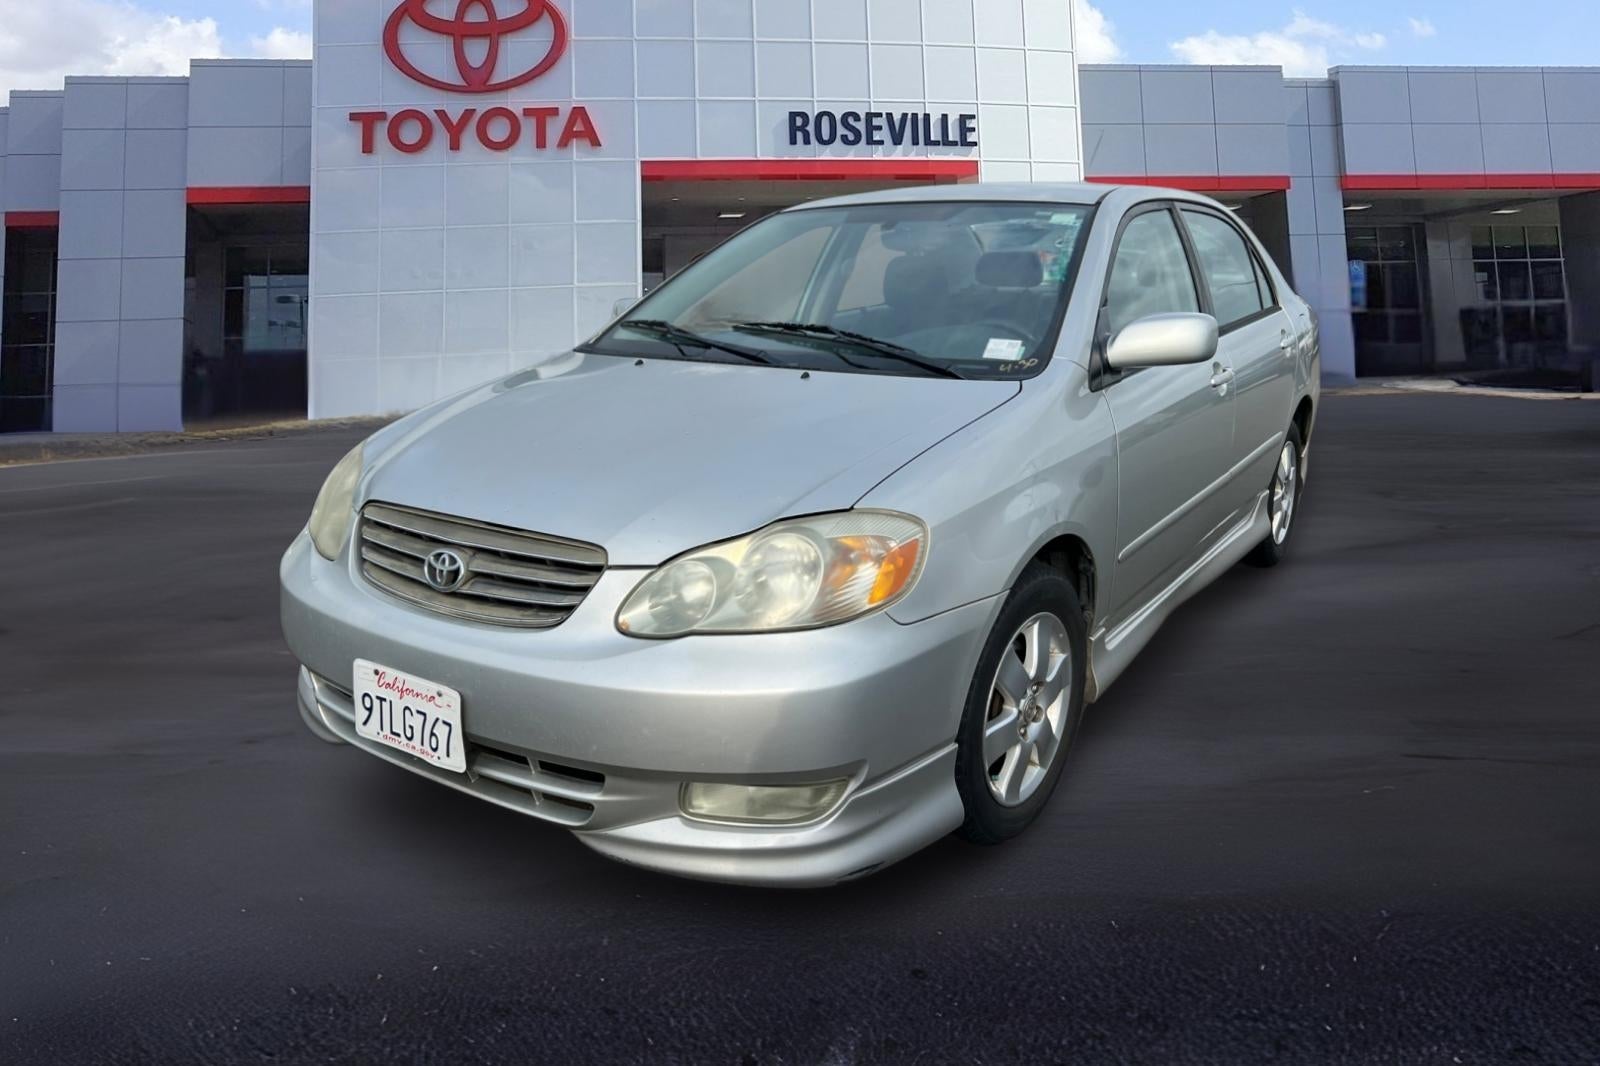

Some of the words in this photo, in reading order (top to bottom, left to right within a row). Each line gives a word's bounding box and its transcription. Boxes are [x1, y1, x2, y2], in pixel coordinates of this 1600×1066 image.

[348, 106, 602, 155] TOYOTA
[788, 110, 978, 147] ROSEVILLE
[376, 670, 442, 708] California
[361, 692, 453, 759] 9TLG767
